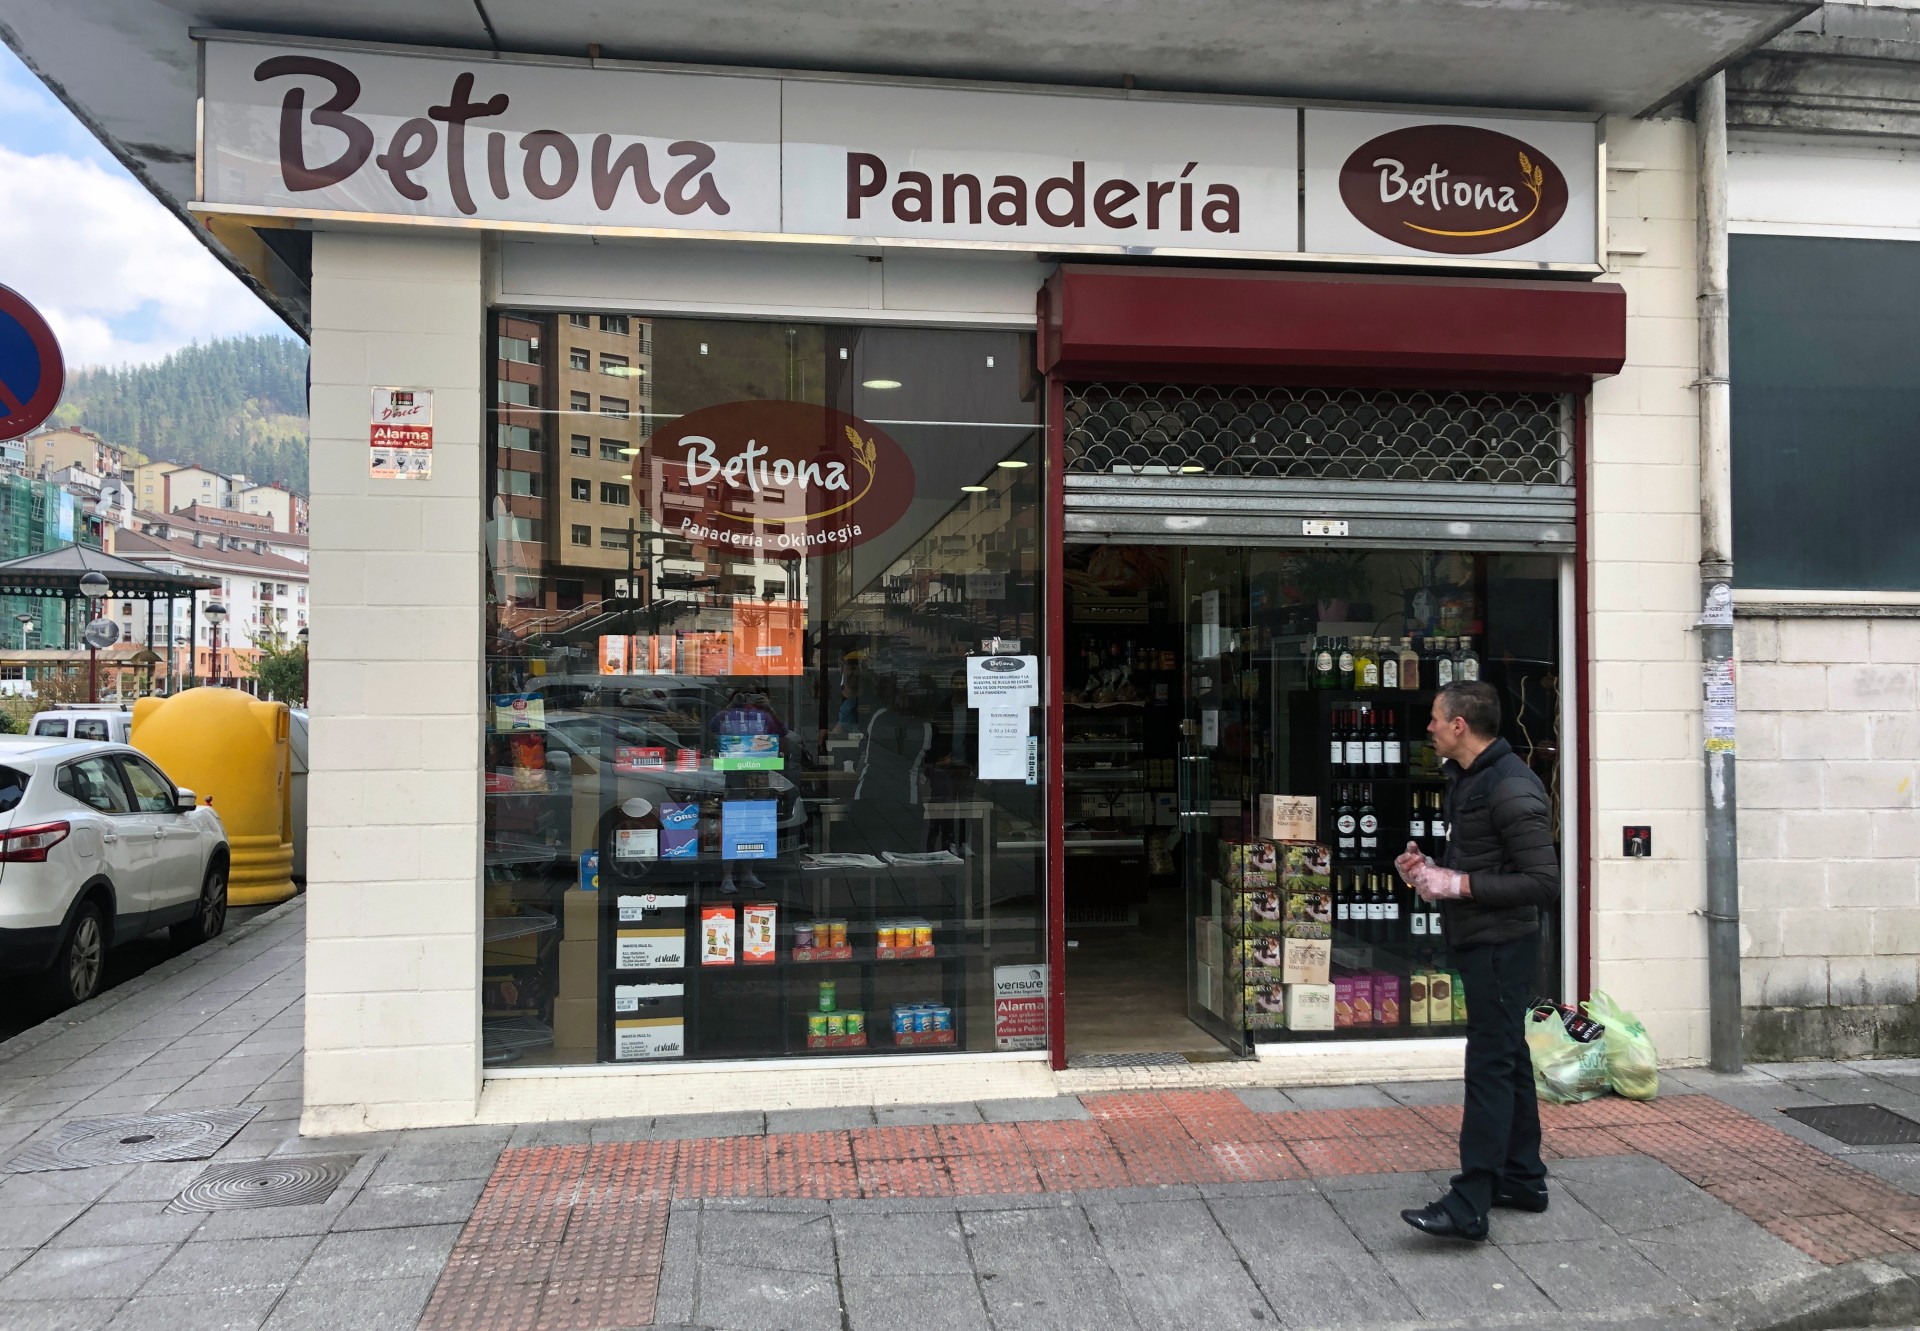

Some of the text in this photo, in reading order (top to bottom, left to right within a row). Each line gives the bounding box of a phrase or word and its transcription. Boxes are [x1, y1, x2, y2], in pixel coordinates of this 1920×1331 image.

[254, 55, 730, 216] Betiona
[847, 152, 1240, 233] Panadería
[1372, 157, 1520, 213] Betiona
[374, 427, 429, 440] Alarma
[678, 435, 849, 493] Betiona
[680, 516, 862, 548] Panadería Okindegia
[673, 813, 698, 822] OREO
[662, 953, 681, 963] Valle
[997, 980, 1044, 990] verisure
[998, 1000, 1044, 1012] Alarma
